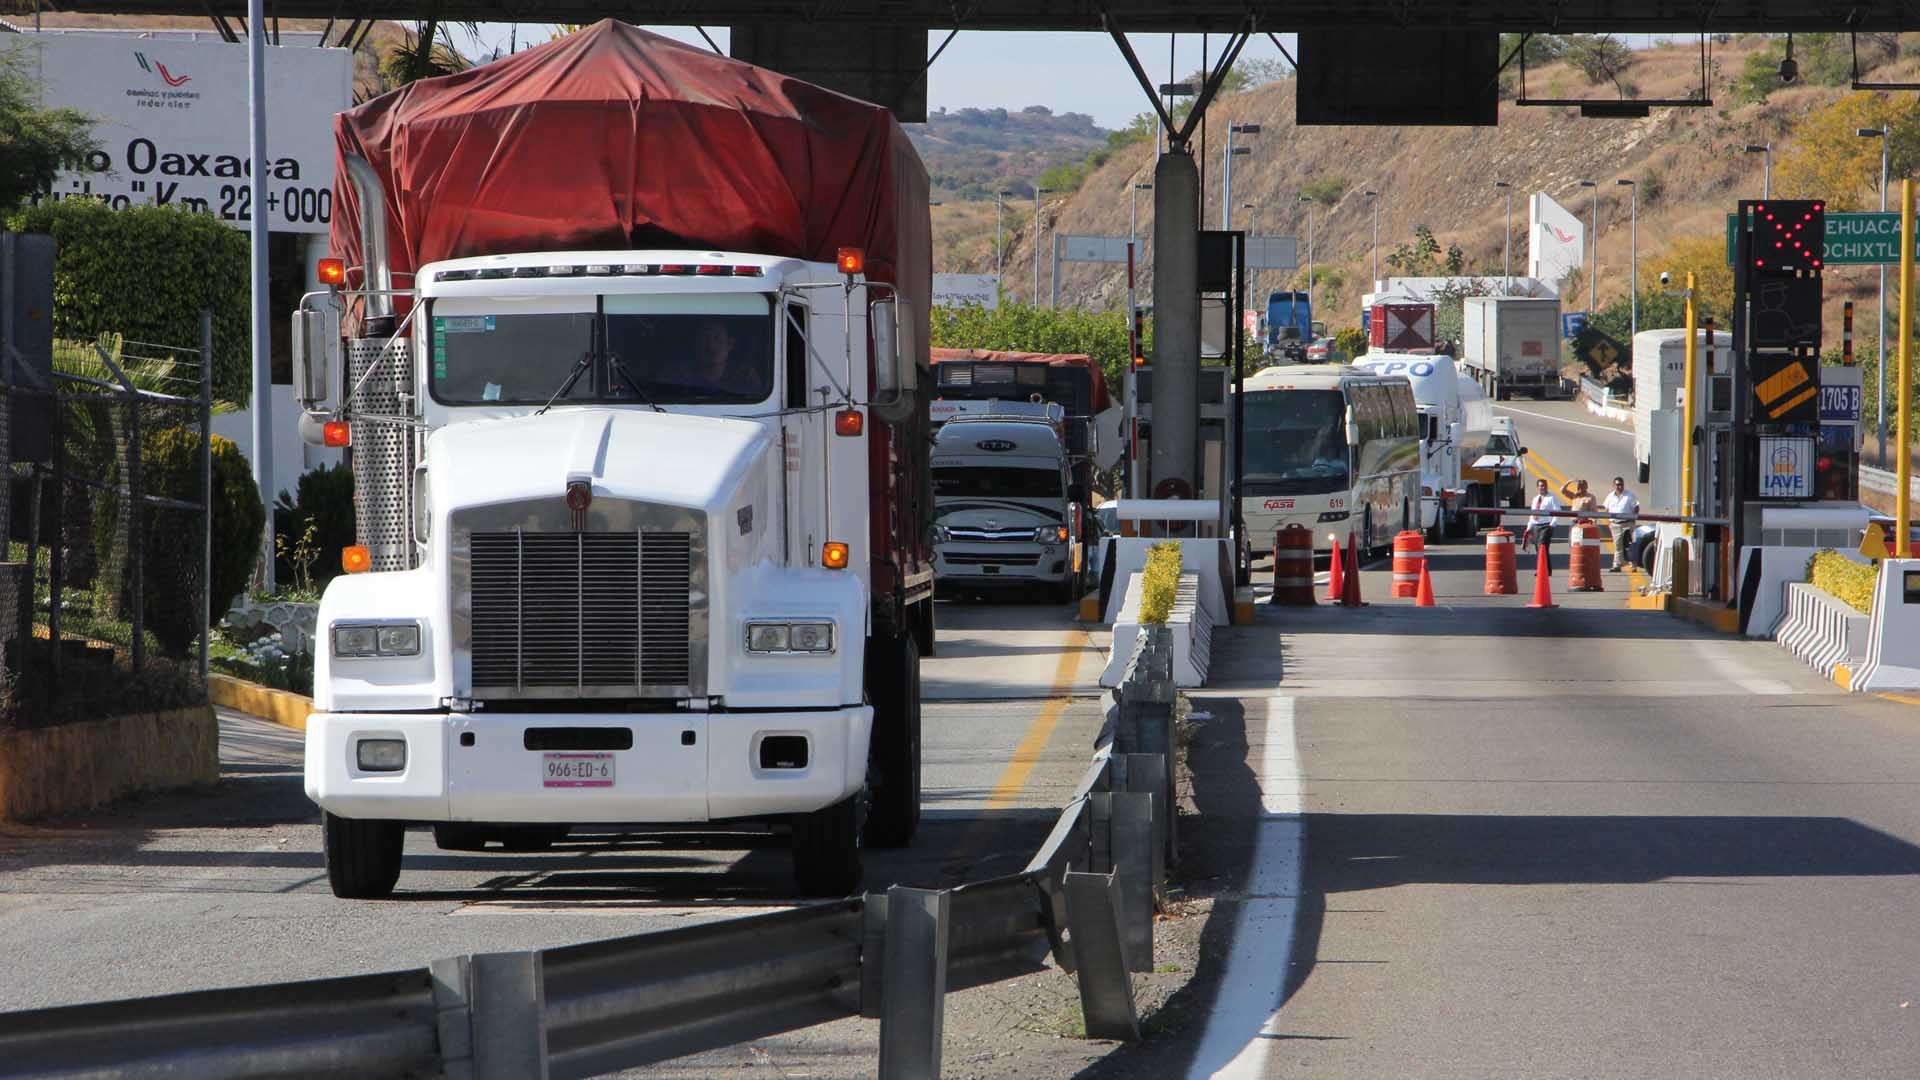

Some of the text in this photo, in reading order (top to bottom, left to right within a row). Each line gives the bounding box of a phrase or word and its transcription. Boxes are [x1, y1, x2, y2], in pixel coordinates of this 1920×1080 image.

[1821, 387, 1859, 411] 1705 B
[1765, 475, 1804, 489] IAVE
[1329, 498, 1344, 508] 619
